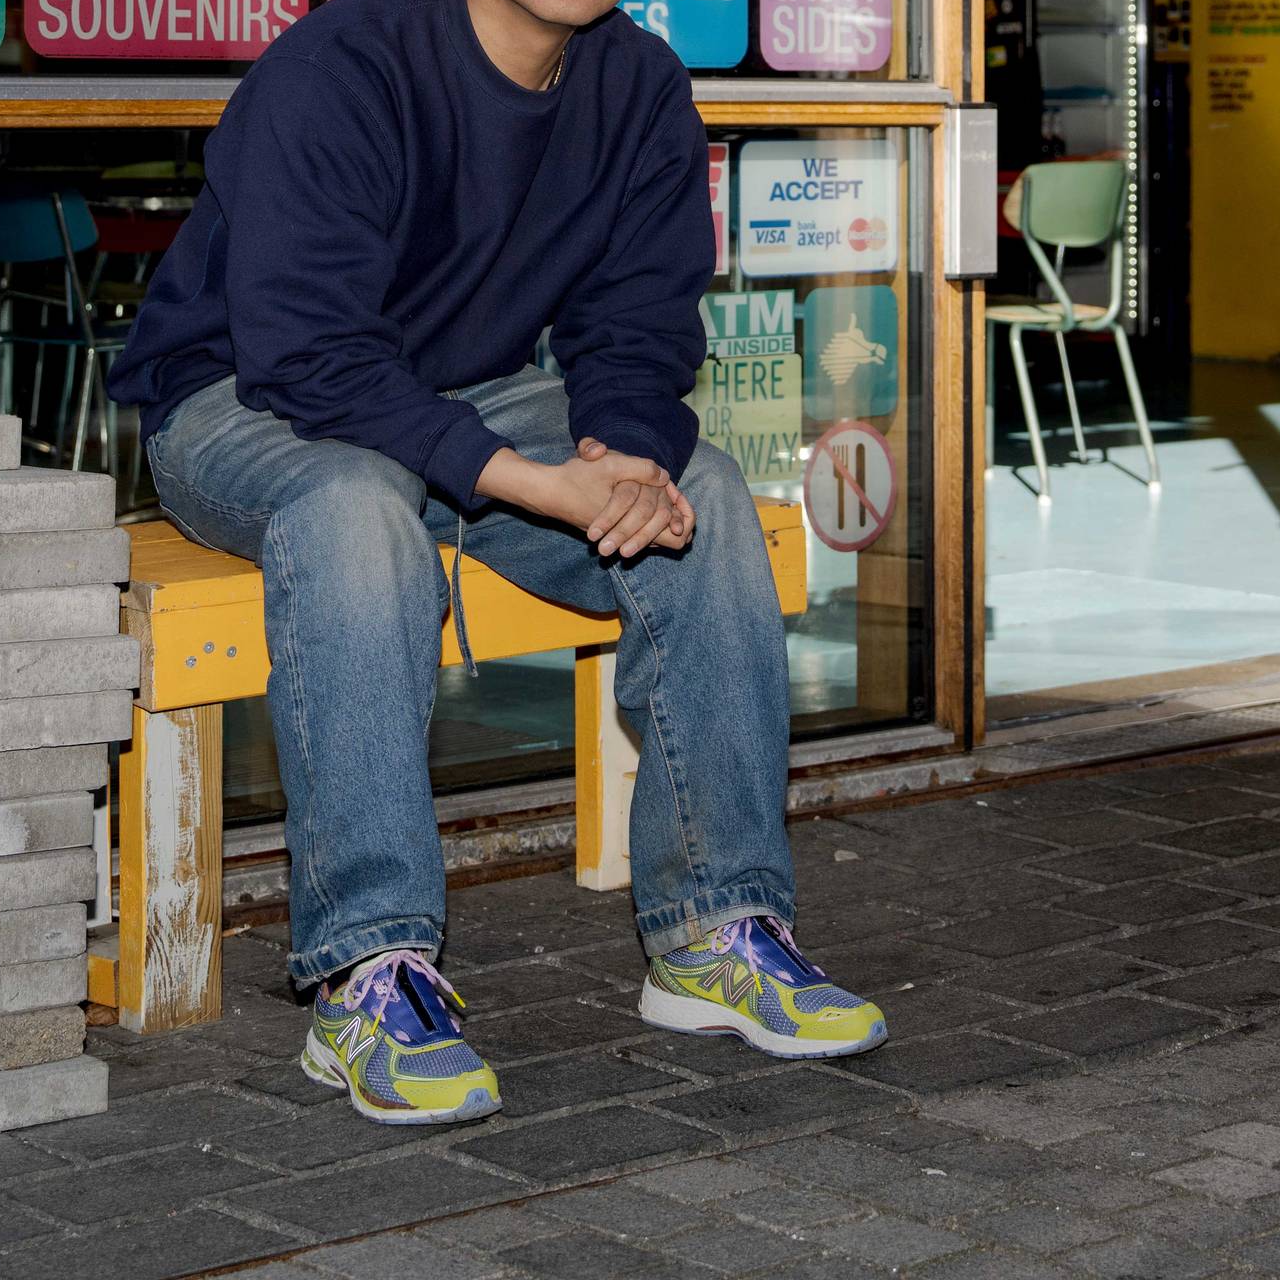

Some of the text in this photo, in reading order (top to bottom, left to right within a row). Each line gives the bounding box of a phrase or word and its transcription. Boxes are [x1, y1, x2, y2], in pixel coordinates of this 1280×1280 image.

[772, 4, 878, 56] SIDES
[802, 158, 839, 177] WE
[769, 181, 863, 202] ACCEPT
[756, 221, 816, 244] VISA bank
[797, 228, 842, 250] axept
[727, 337, 793, 356] INSIDE
[712, 359, 785, 404] HERE
[706, 406, 733, 437] OR
